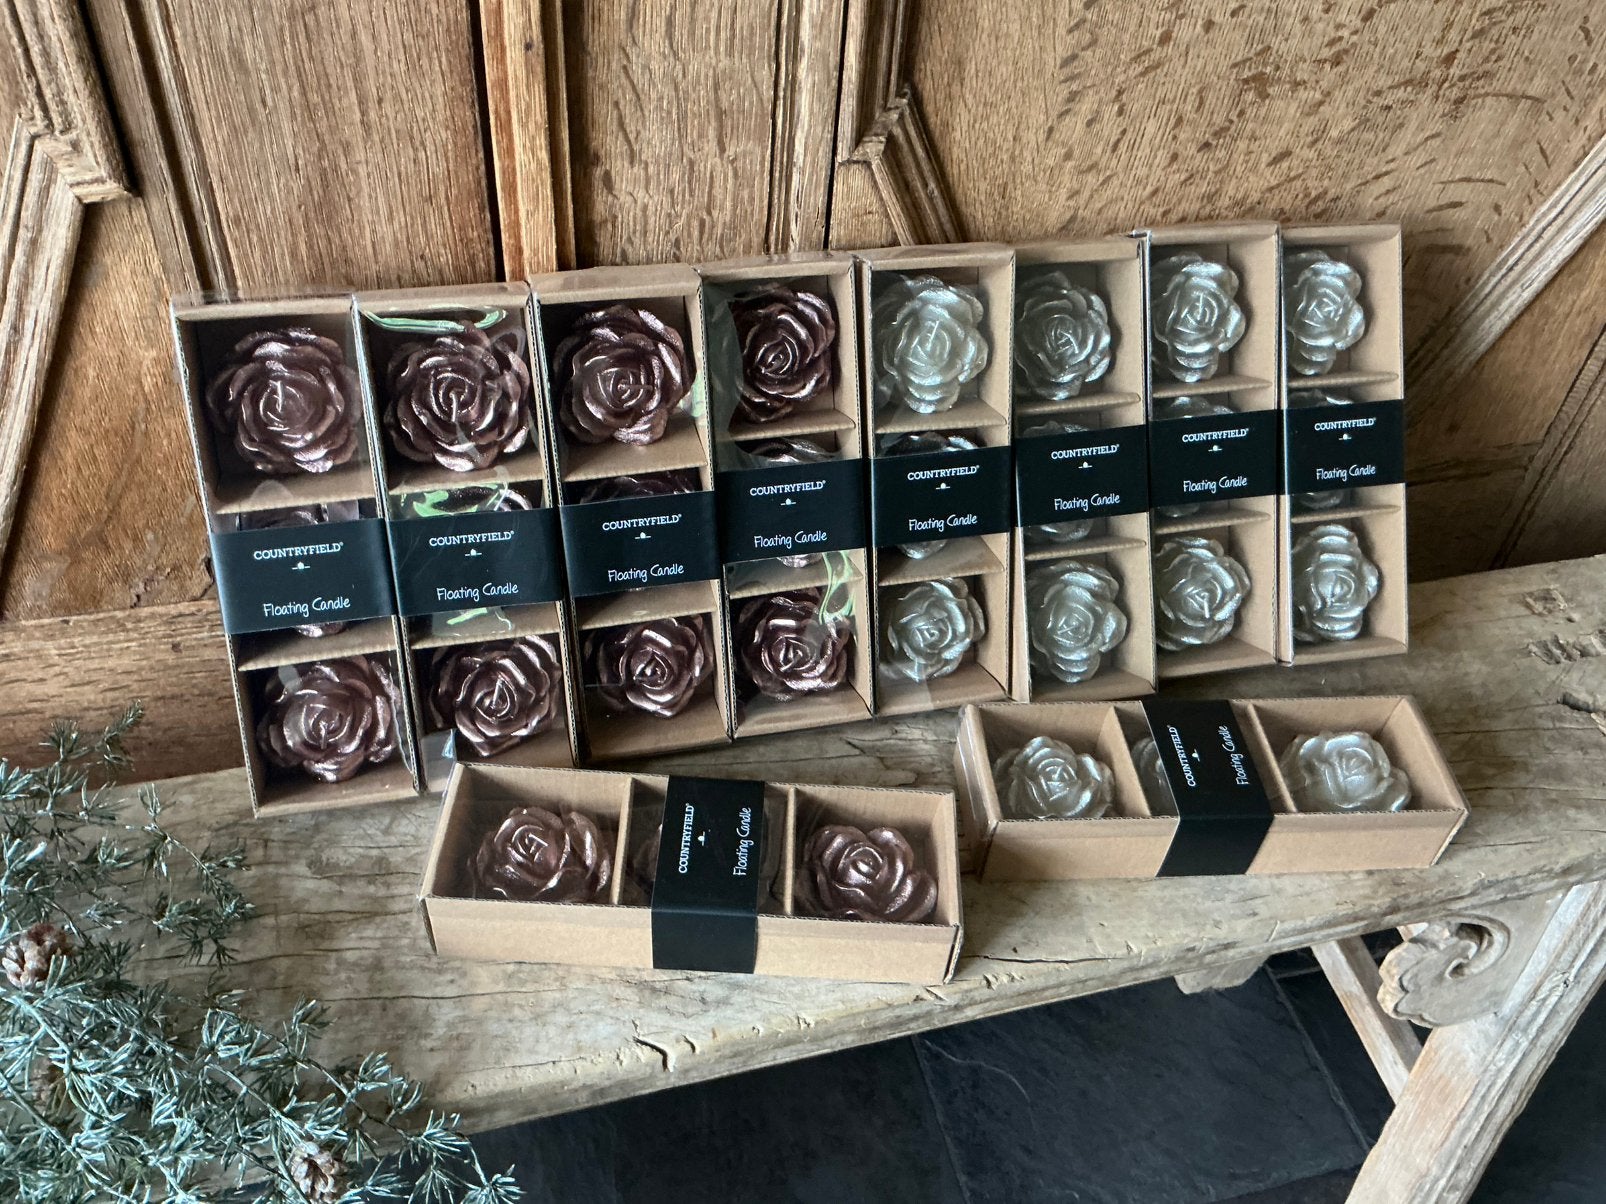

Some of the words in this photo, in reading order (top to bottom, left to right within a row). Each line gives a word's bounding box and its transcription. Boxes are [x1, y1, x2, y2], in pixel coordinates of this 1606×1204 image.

[1316, 468, 1346, 481] Floating
[1349, 465, 1375, 477] Candle
[1183, 480, 1216, 493] Floating
[1219, 476, 1247, 488] Candle
[1054, 497, 1088, 511] Floating
[1090, 493, 1120, 505] Candle
[909, 518, 944, 532] Floating
[947, 514, 977, 526] Candle
[754, 535, 792, 549] Floating
[795, 531, 827, 543] Candle
[608, 568, 647, 582] Floating
[650, 564, 684, 576] Candle
[437, 587, 479, 602] Floating
[483, 582, 519, 595] Candle
[263, 602, 309, 617] Floating
[312, 596, 350, 611] Candle
[1218, 726, 1235, 752] Candle
[1231, 754, 1249, 784] Floating
[736, 808, 751, 837] Candle
[733, 840, 754, 875] Floating
